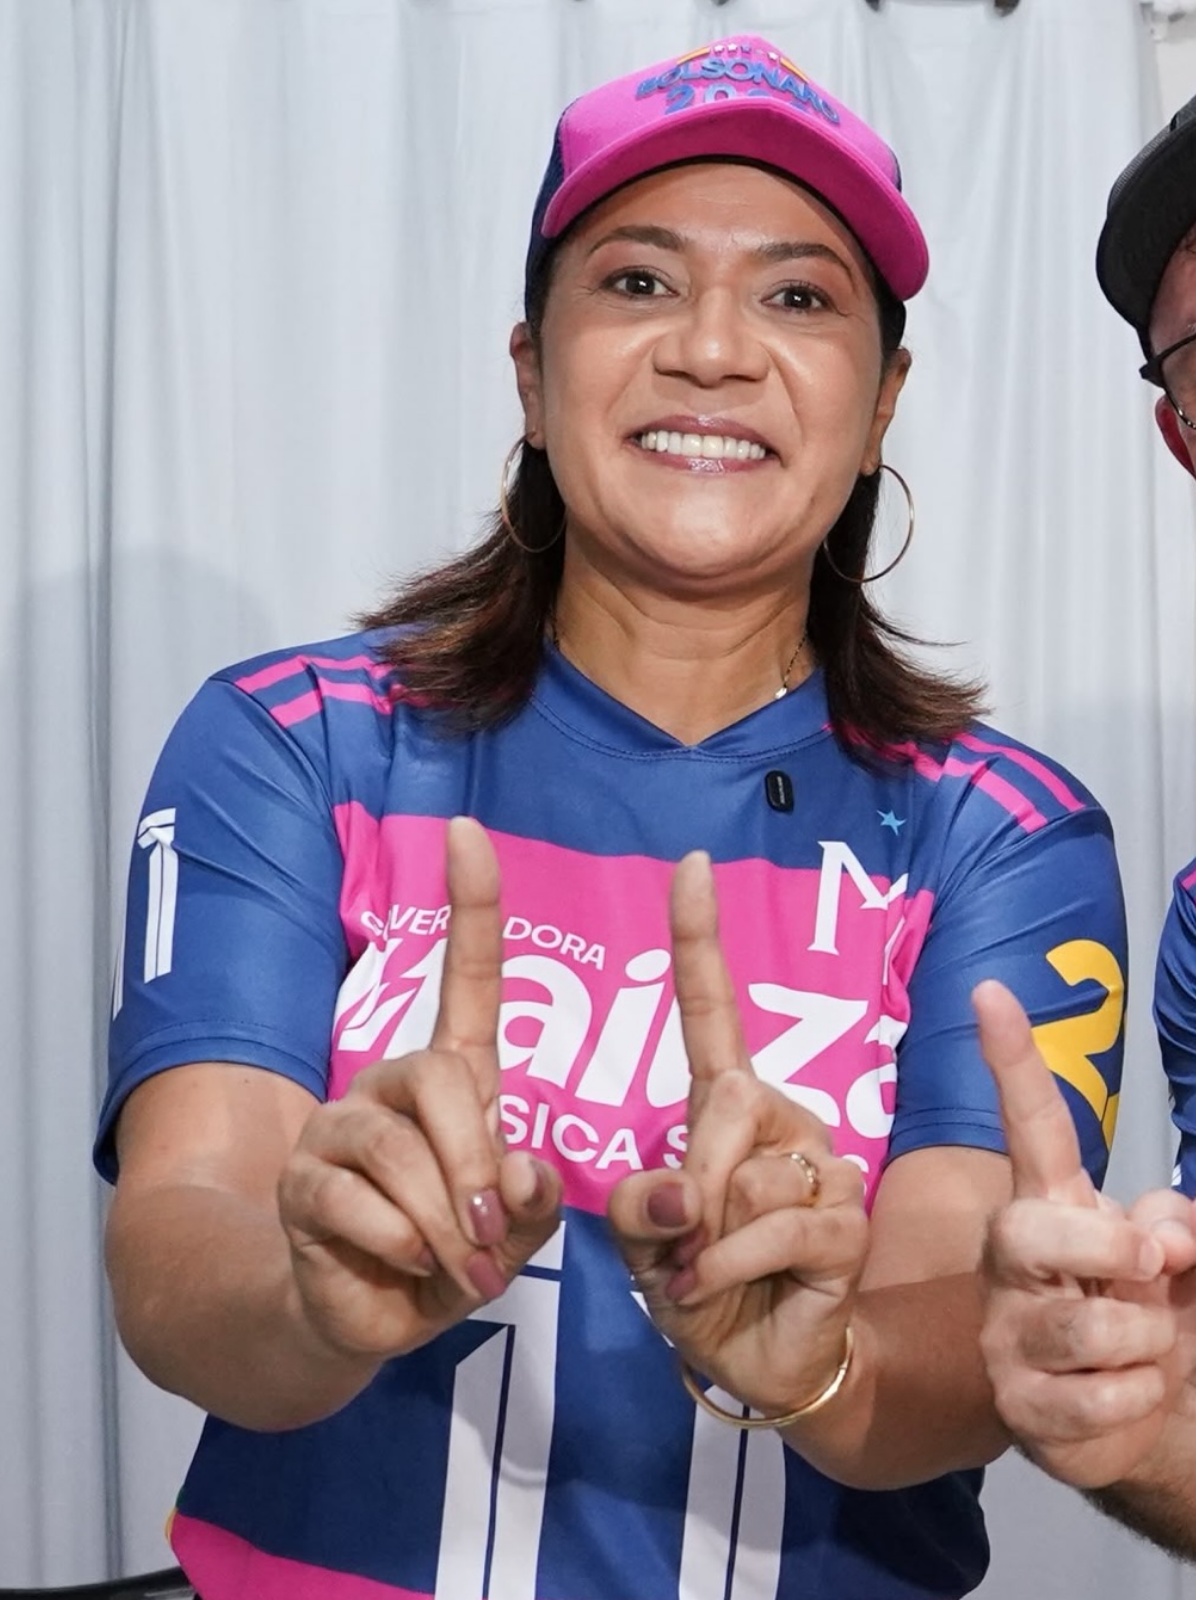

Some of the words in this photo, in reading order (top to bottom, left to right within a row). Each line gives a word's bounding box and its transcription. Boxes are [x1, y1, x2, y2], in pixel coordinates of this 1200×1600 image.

[635, 57, 840, 125] BOLSONARO
[360, 904, 606, 971] GVERDORA
[499, 1094, 643, 1170] SICA
